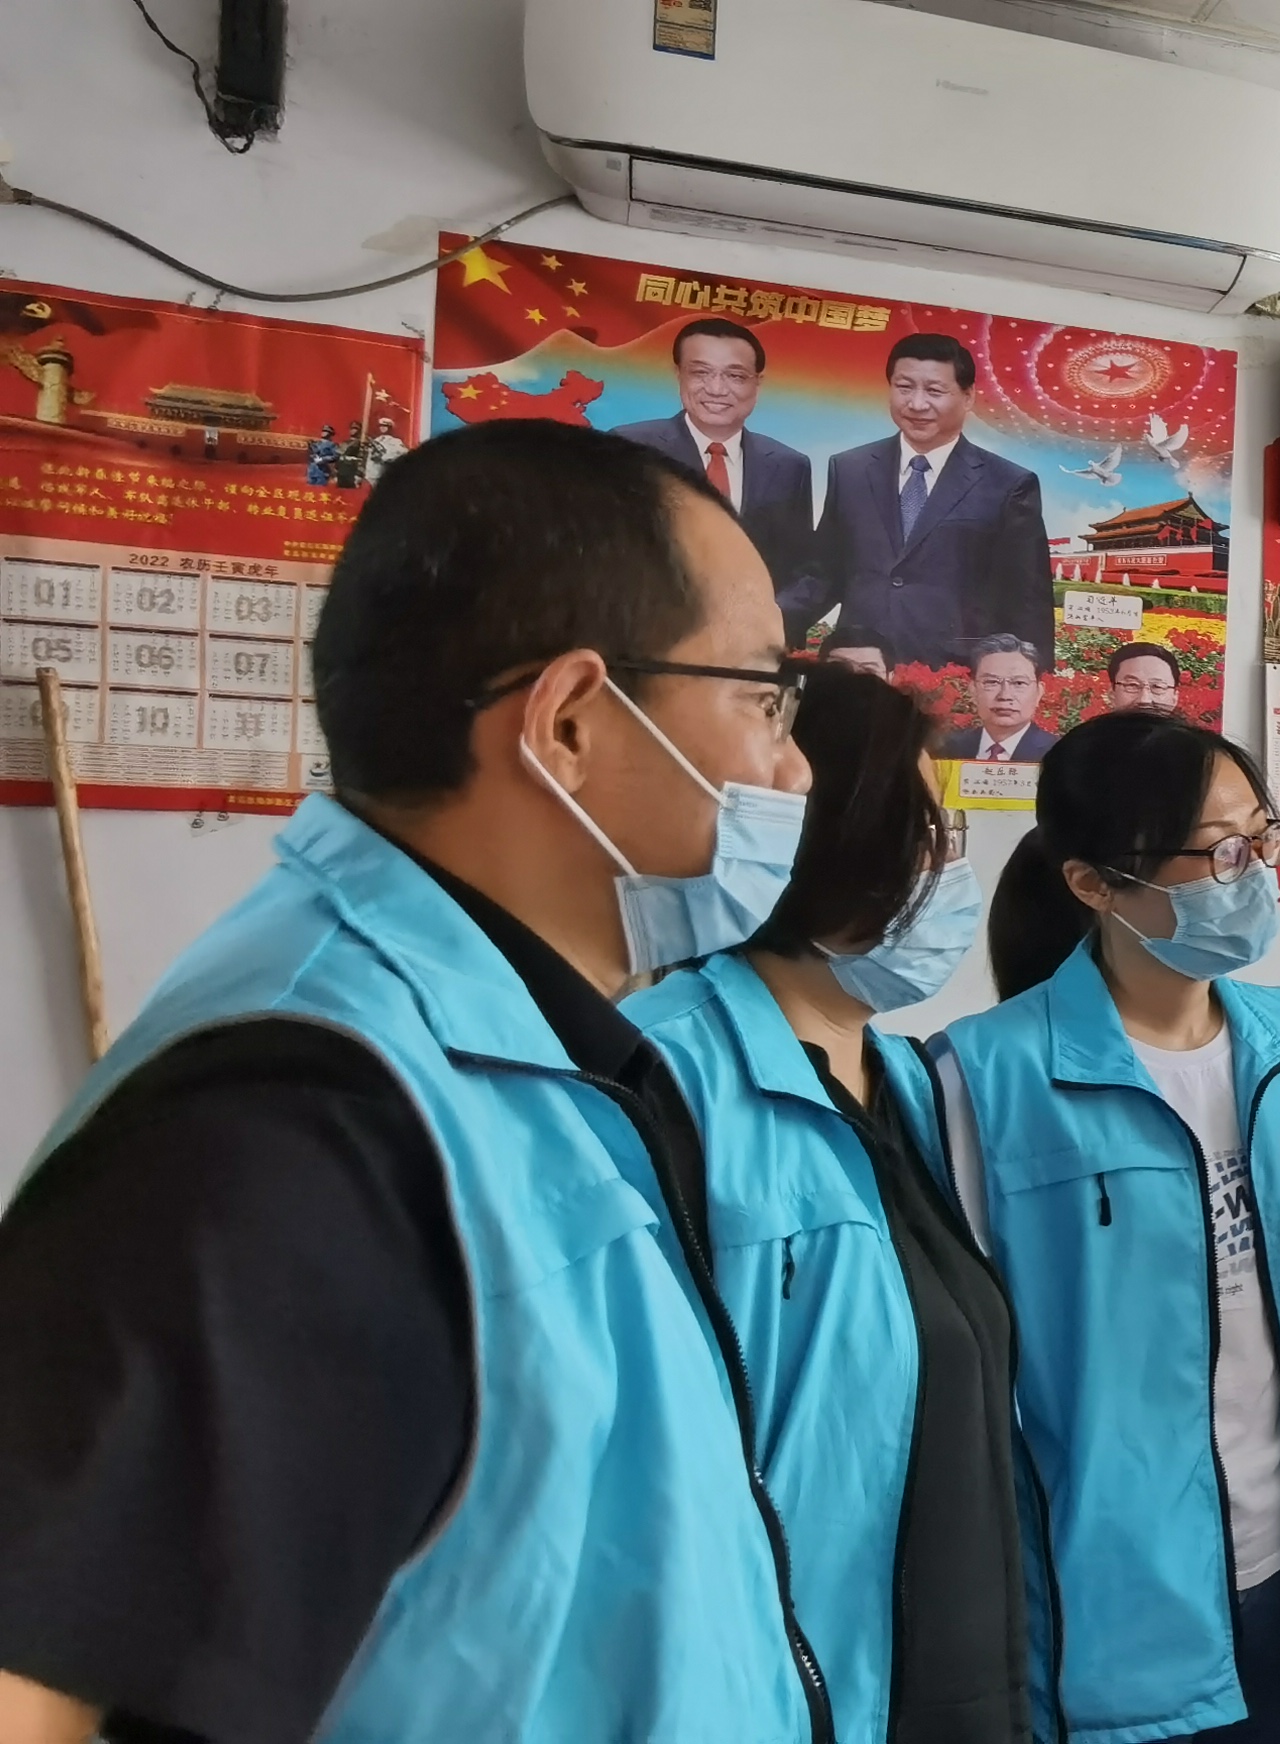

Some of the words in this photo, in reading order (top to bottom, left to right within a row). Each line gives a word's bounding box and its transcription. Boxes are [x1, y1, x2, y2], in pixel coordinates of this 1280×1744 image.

[635, 273, 892, 332] 同心共筑中国梦
[129, 553, 170, 568] 2022
[180, 557, 279, 579] 农历壬寅虎年
[34, 579, 72, 608] 01
[136, 587, 176, 615] 02
[234, 594, 274, 623] 03
[32, 636, 73, 664] 05
[135, 644, 175, 671] 06
[234, 651, 270, 678] 07
